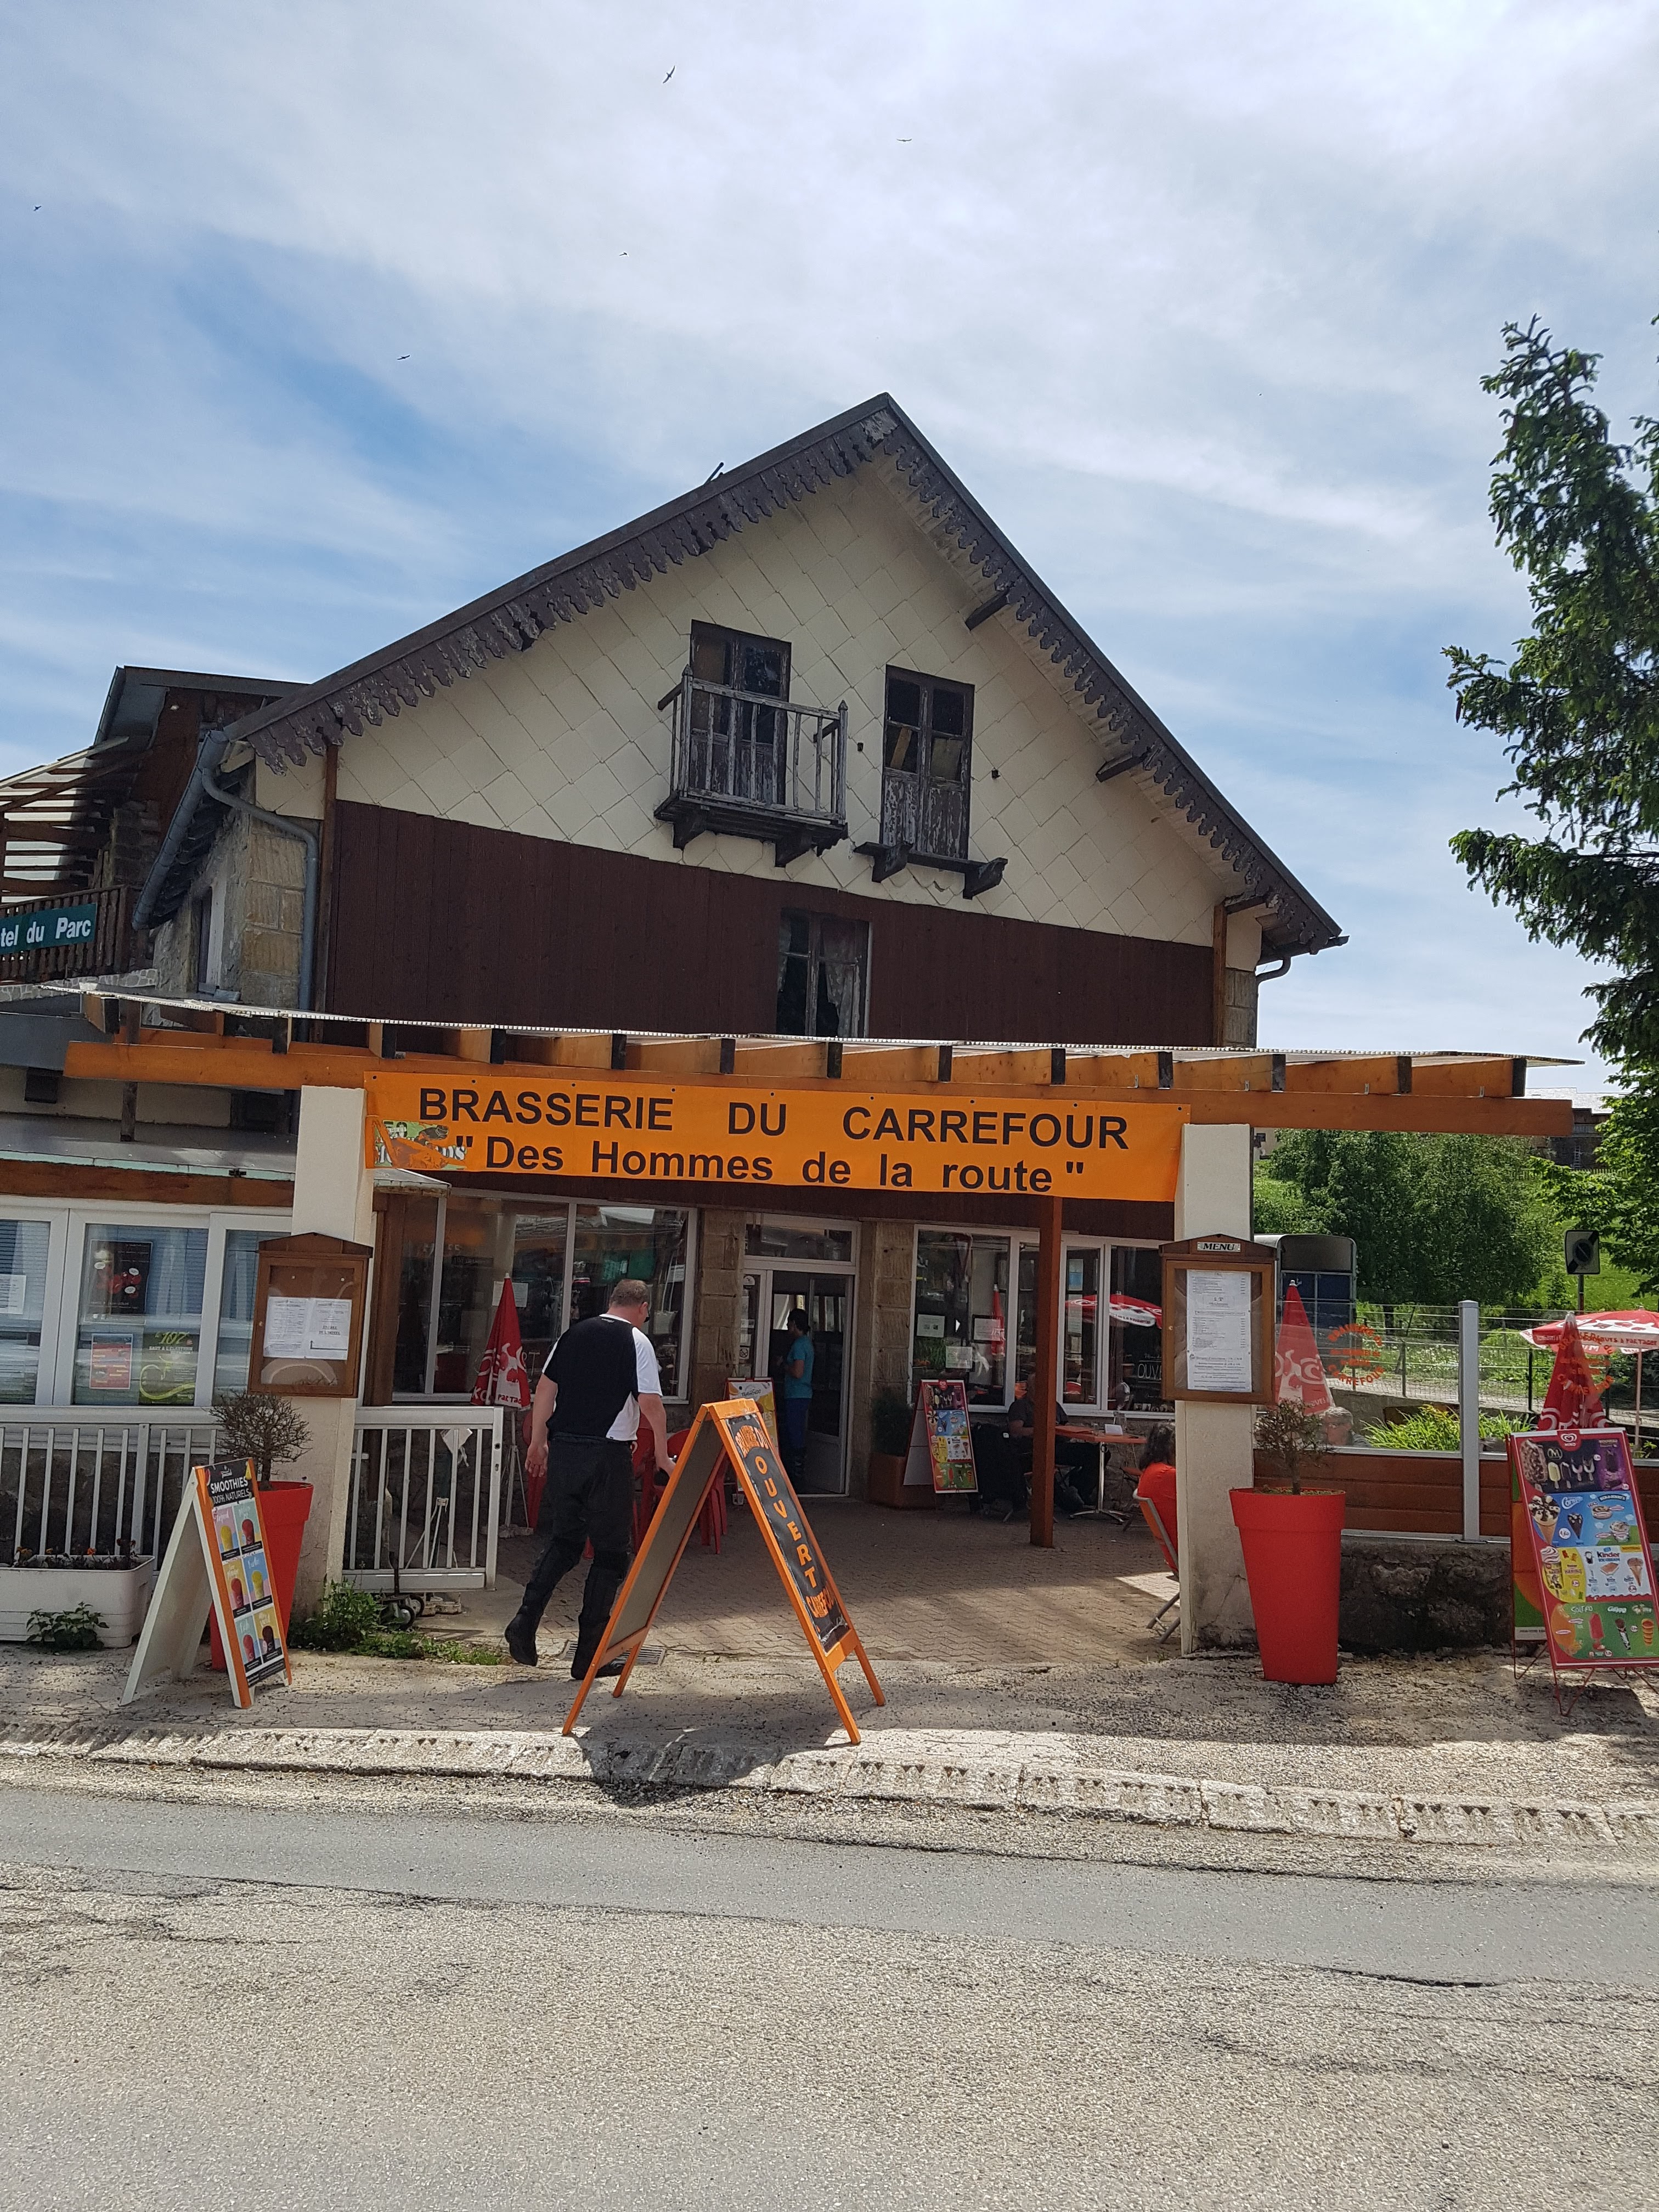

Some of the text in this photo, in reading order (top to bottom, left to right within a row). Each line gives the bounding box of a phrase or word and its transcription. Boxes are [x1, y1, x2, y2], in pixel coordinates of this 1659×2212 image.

[1, 917, 92, 947] tel du Parc
[419, 1087, 673, 1131] BRASSERIE
[729, 1102, 787, 1136] DU
[842, 1106, 1129, 1150] CARREFOUR
[591, 1140, 774, 1181] Hommes
[802, 1151, 851, 1184] de
[880, 1154, 913, 1188] la
[1203, 1243, 1235, 1251] MENU
[210, 1476, 248, 1494] SMOOTHIES
[225, 1488, 250, 1502] NATURELS
[755, 1456, 817, 1588] OUVERT
